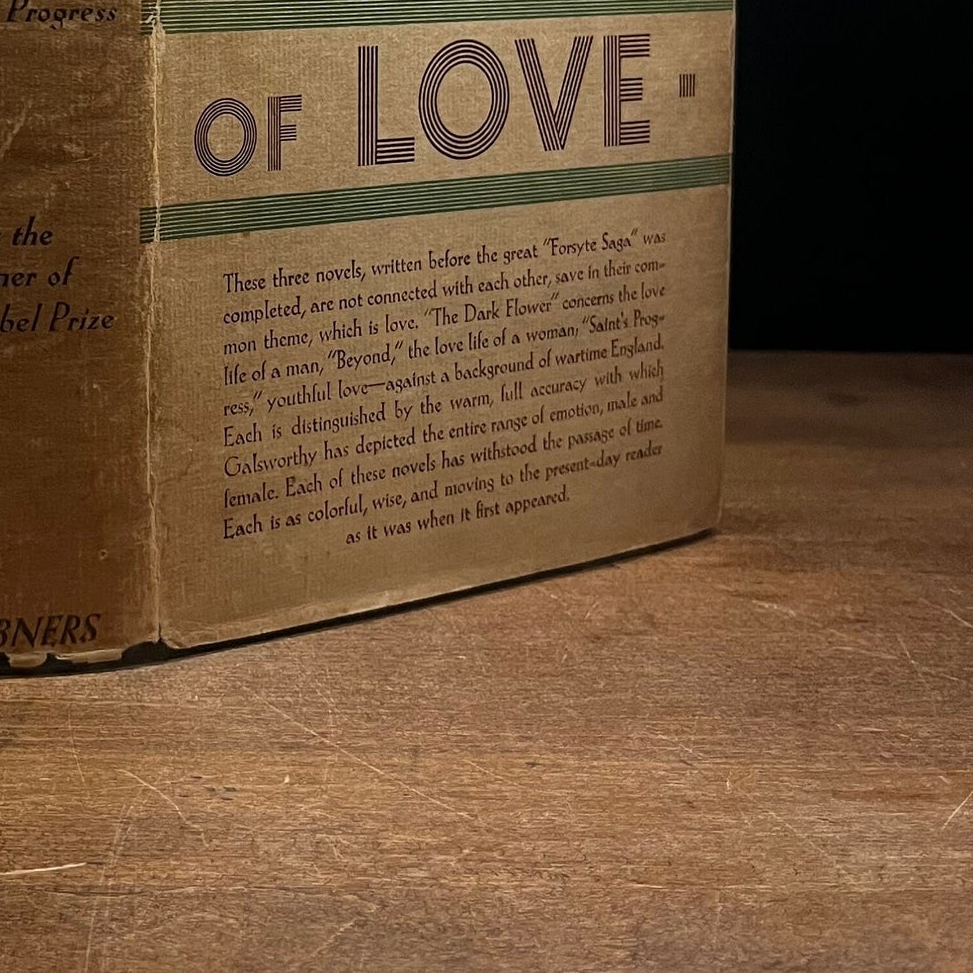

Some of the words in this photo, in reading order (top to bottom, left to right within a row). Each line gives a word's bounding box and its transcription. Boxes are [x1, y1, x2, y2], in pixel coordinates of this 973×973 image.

[194, 95, 302, 176] OF
[357, 32, 651, 167] LOVE
[12, 216, 52, 246] the
[48, 256, 80, 286] of
[223, 273, 265, 293] These
[273, 268, 309, 287] three
[316, 259, 365, 282] novels,
[372, 259, 421, 275] written
[429, 249, 470, 269] before
[477, 245, 497, 264] the
[504, 245, 538, 265] great
[644, 233, 666, 244] was
[49, 302, 114, 332] Prize
[224, 340, 256, 355] mon
[264, 329, 313, 349] theme,
[320, 318, 362, 342] which
[369, 321, 378, 335] is
[386, 314, 418, 333] love.
[465, 301, 499, 322] Dark
[563, 294, 614, 309] concerns
[619, 284, 637, 302] the
[642, 282, 665, 299] love
[346, 532, 360, 544] as
[367, 526, 377, 540] it
[384, 522, 411, 536] was
[418, 509, 454, 530] when
[461, 508, 470, 522] it
[477, 500, 500, 518] first
[505, 488, 570, 514] appeared.
